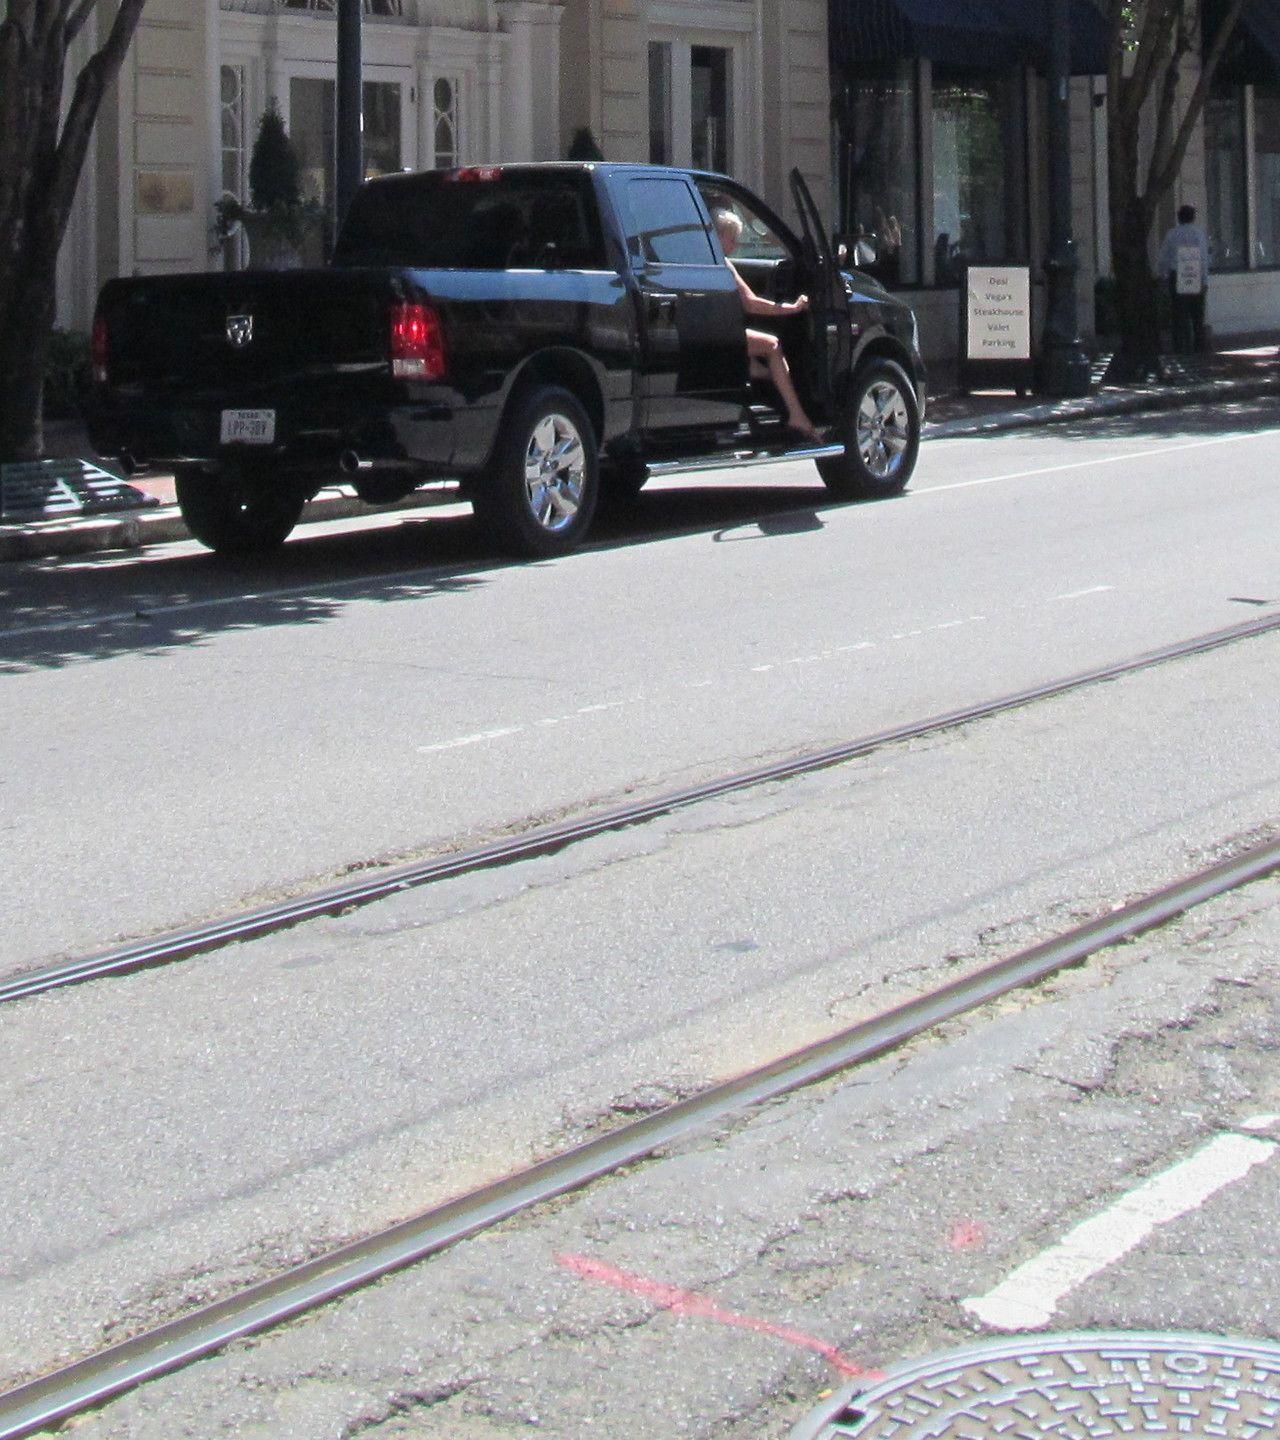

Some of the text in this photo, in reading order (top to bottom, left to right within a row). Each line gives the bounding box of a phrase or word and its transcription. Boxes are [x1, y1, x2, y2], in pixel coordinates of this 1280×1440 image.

[973, 307, 1024, 316] Steakhouse
[987, 323, 1010, 331] Valet
[982, 339, 1016, 348] Parking
